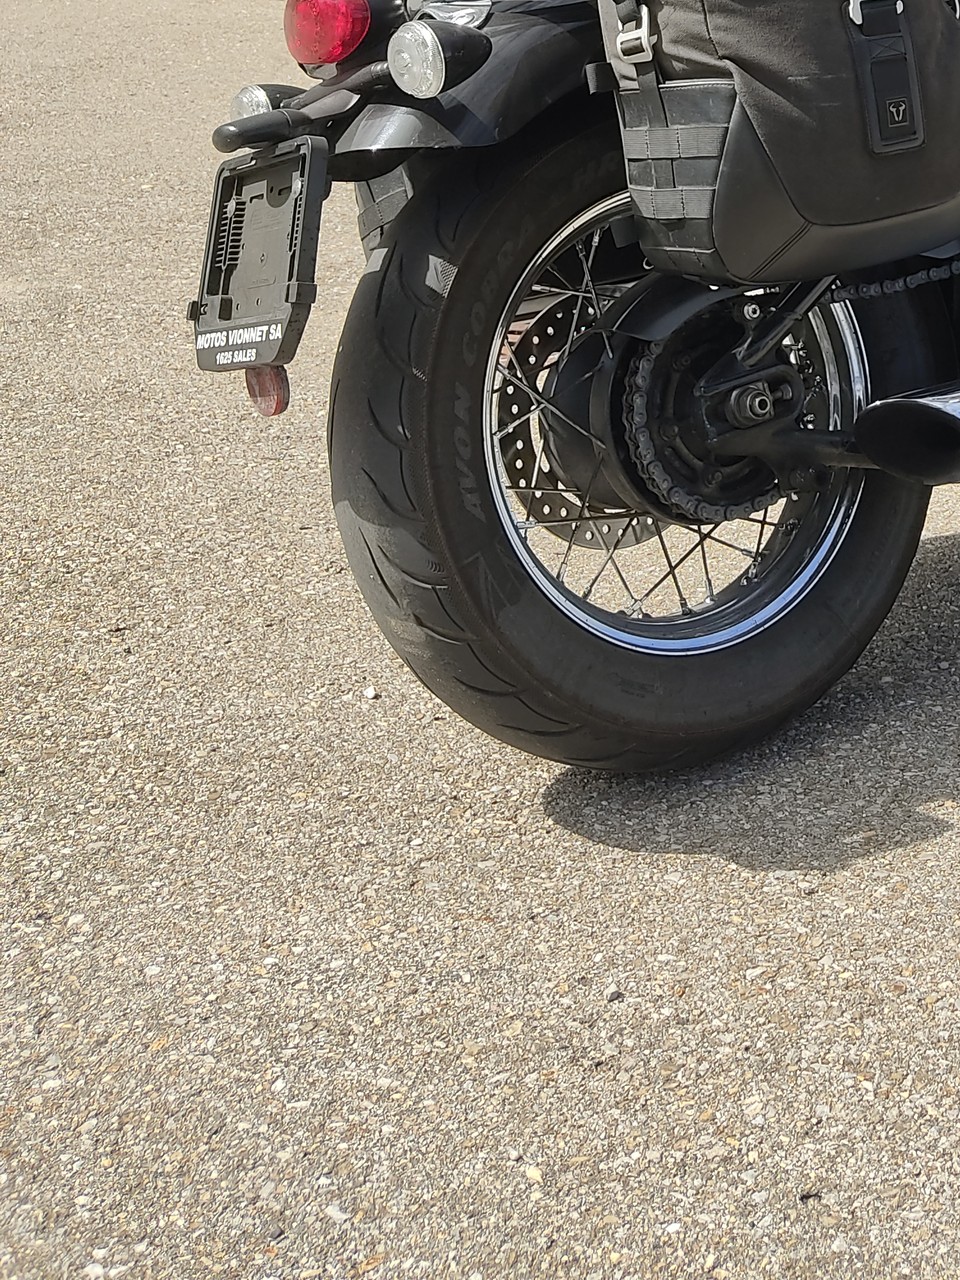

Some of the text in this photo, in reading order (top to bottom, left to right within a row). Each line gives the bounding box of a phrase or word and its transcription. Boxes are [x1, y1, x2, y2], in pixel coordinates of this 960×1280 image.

[196, 323, 282, 349] MOTOS VIONNET SA
[215, 348, 257, 365] 1625 SALES
[454, 381, 487, 523] AVON
